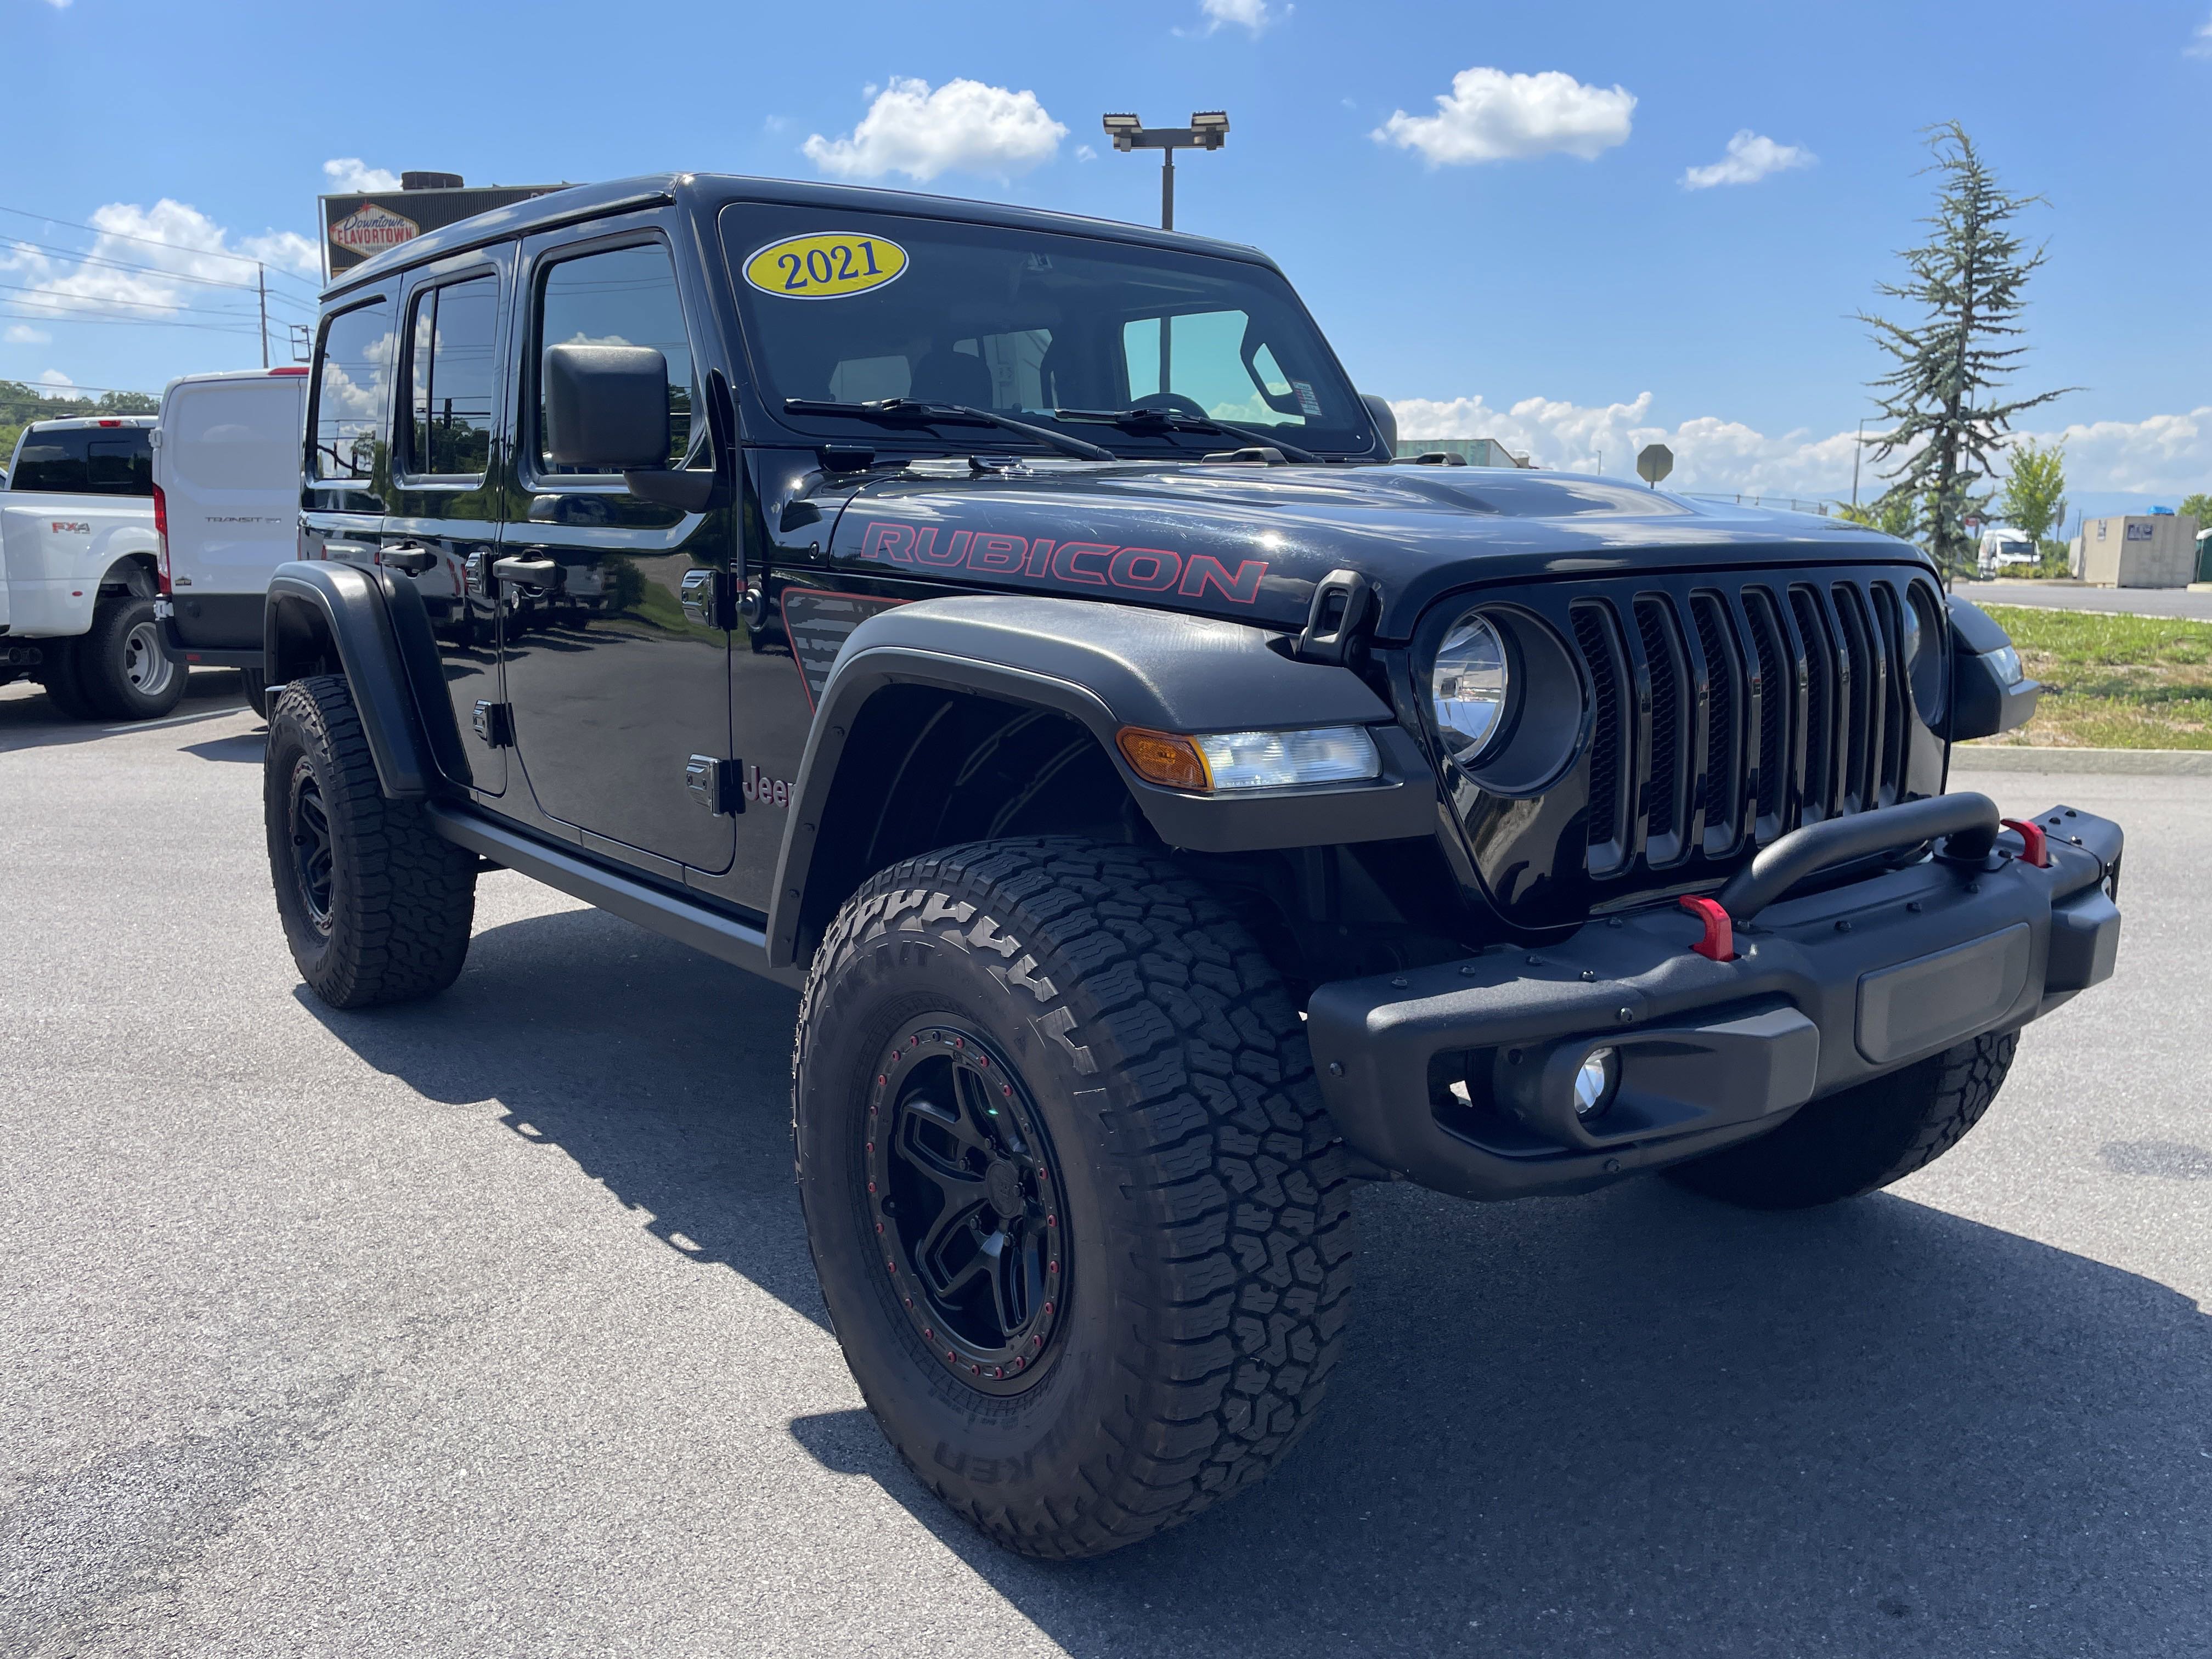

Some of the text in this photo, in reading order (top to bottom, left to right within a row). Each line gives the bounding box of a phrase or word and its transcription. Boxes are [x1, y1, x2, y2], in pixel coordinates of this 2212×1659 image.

[344, 214, 405, 231] Downtown
[337, 228, 413, 245] FLAVORTOWN
[777, 240, 883, 290] 2021
[52, 521, 91, 534] FX4
[860, 521, 1269, 603] RUBICON
